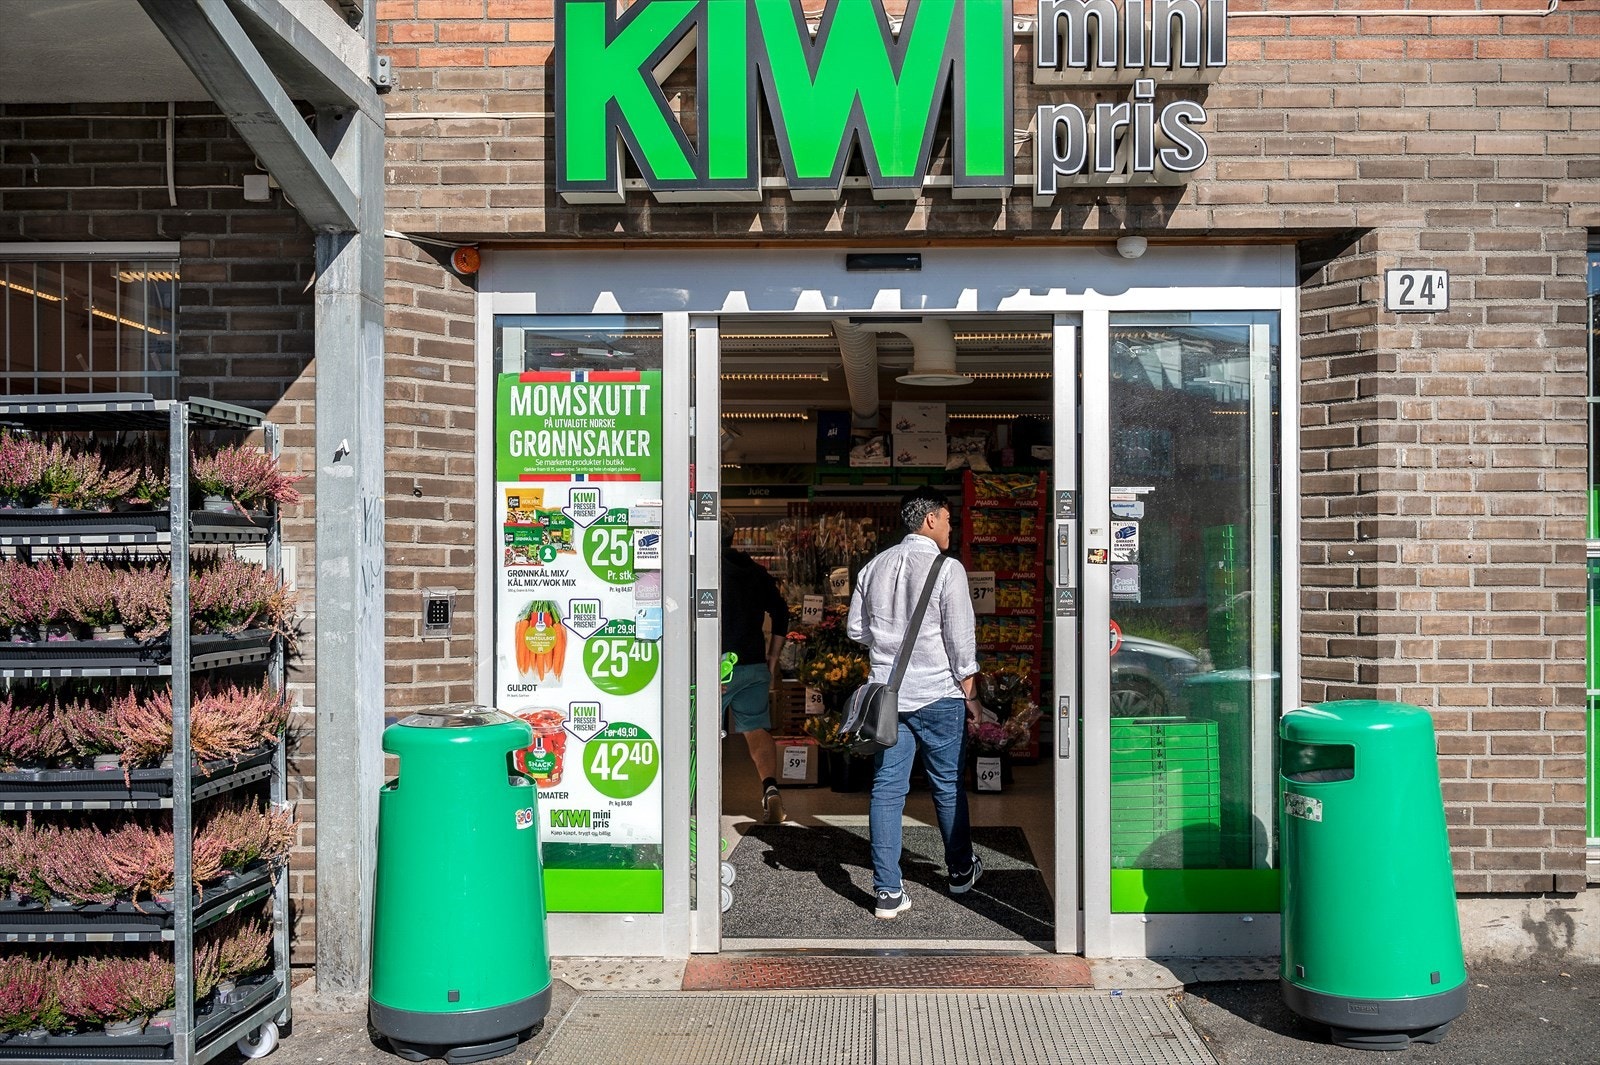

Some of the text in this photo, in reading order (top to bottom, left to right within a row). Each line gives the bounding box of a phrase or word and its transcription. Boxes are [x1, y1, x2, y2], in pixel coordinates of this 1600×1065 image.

[1036, 0, 1227, 69] mini
[555, 0, 1014, 193] KIWI
[1037, 79, 1207, 195] pris
[510, 384, 651, 416] MOMSKUTT
[544, 417, 616, 428] PÅ UTVALGTE NORSKE
[509, 430, 651, 457] GRØNNSAKER
[535, 458, 543, 466] Se
[544, 458, 572, 466] markerte
[572, 458, 601, 467] produkter
[606, 458, 625, 466] butikk
[747, 487, 771, 496] Juice
[573, 492, 596, 502] KIWI
[507, 568, 549, 577] GRØNNKÅL
[608, 570, 634, 580] Pr. stk.
[508, 578, 523, 586] KÅL
[574, 604, 596, 614] KIWI
[604, 624, 615, 634] Før
[573, 706, 596, 716] KIWI
[604, 728, 637, 738] Før 49,90
[591, 742, 653, 781] 4240
[550, 810, 591, 828] KIWI
[592, 810, 611, 818] mini
[592, 819, 609, 830] pris
